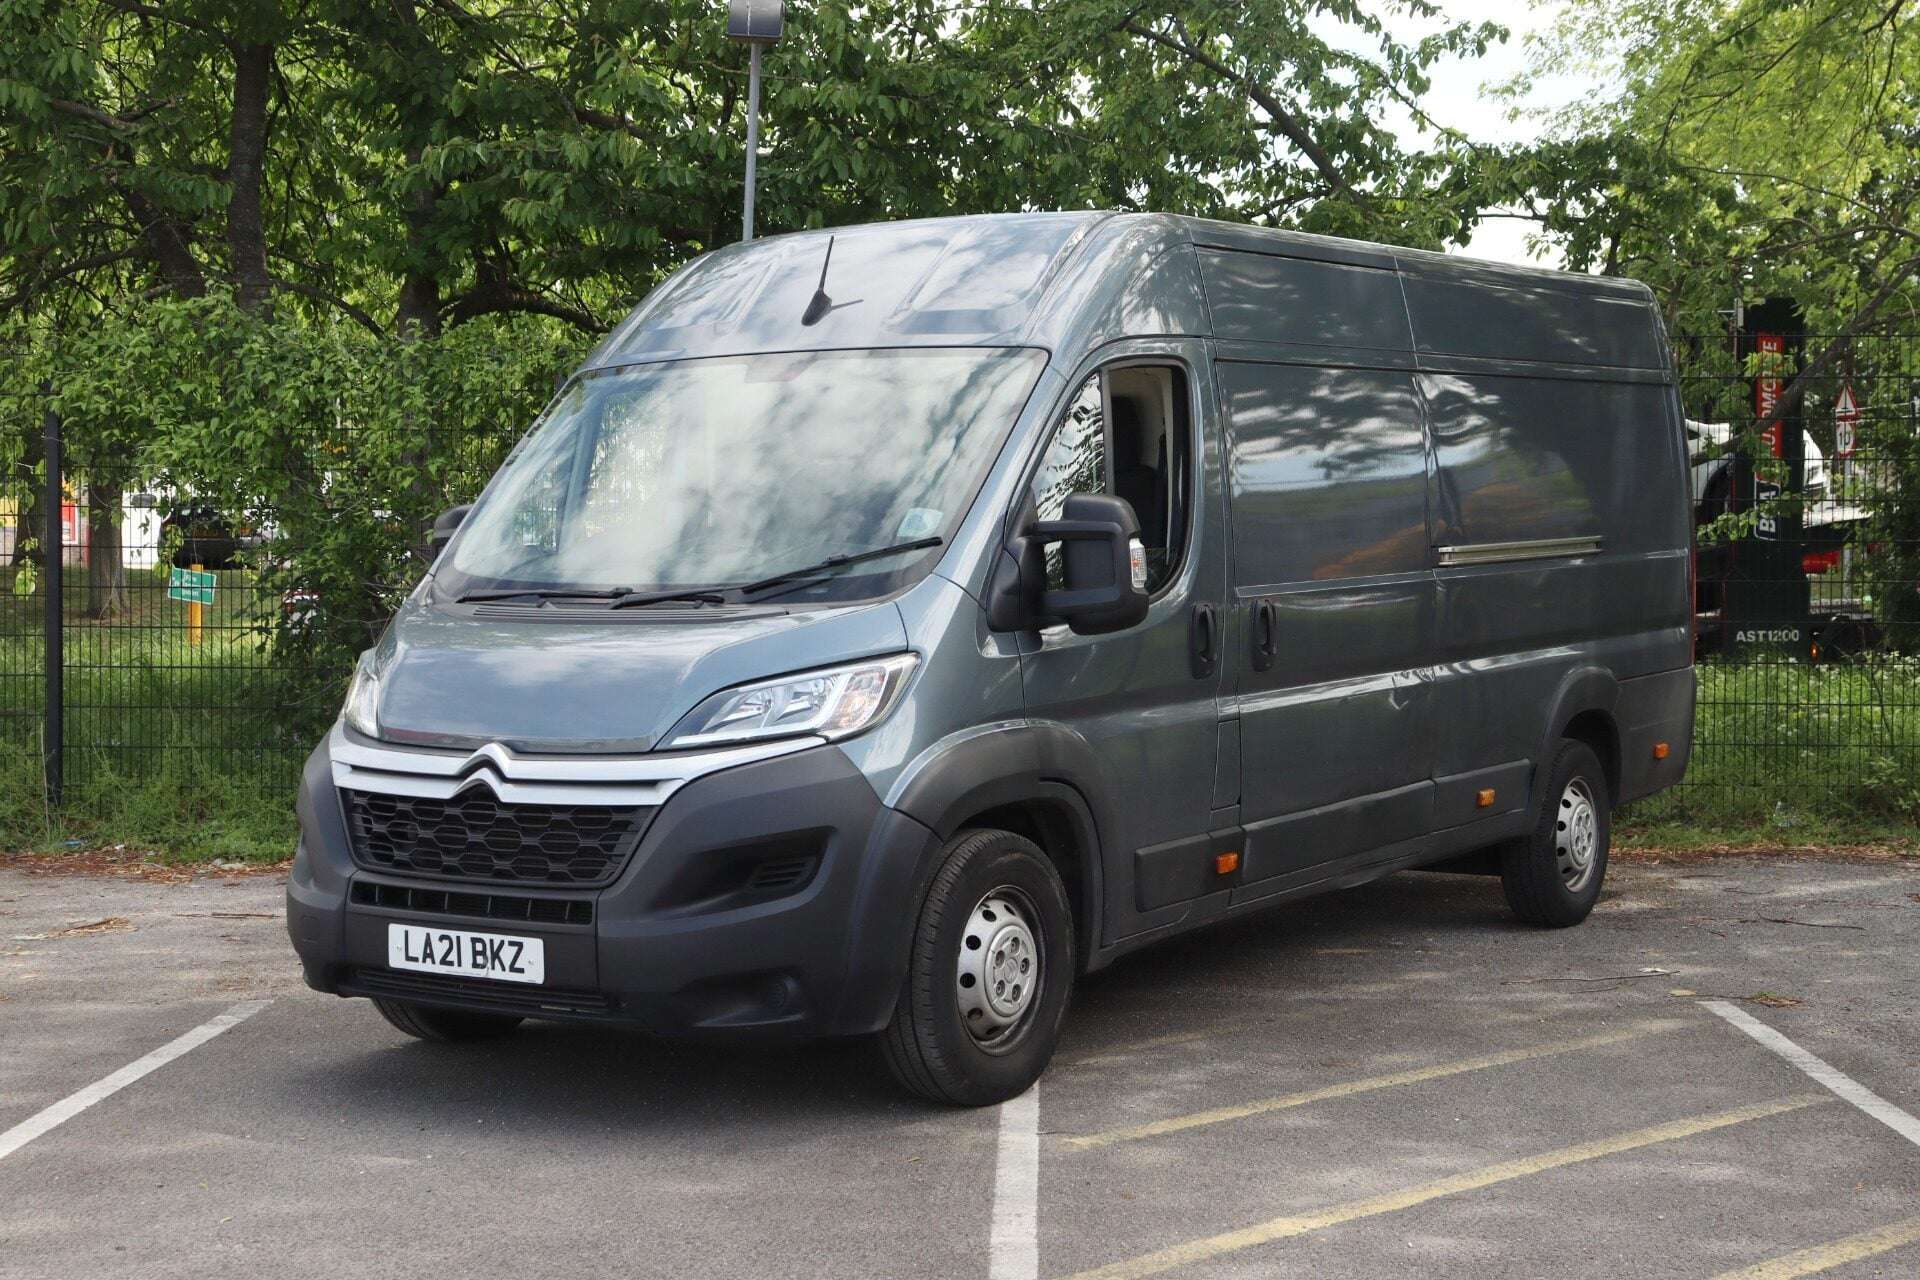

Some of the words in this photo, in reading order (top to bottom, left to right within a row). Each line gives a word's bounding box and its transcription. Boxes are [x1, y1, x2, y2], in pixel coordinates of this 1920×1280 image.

[1760, 491, 1776, 533] BA
[404, 929, 462, 968] LA21
[470, 936, 525, 974] BKZ
